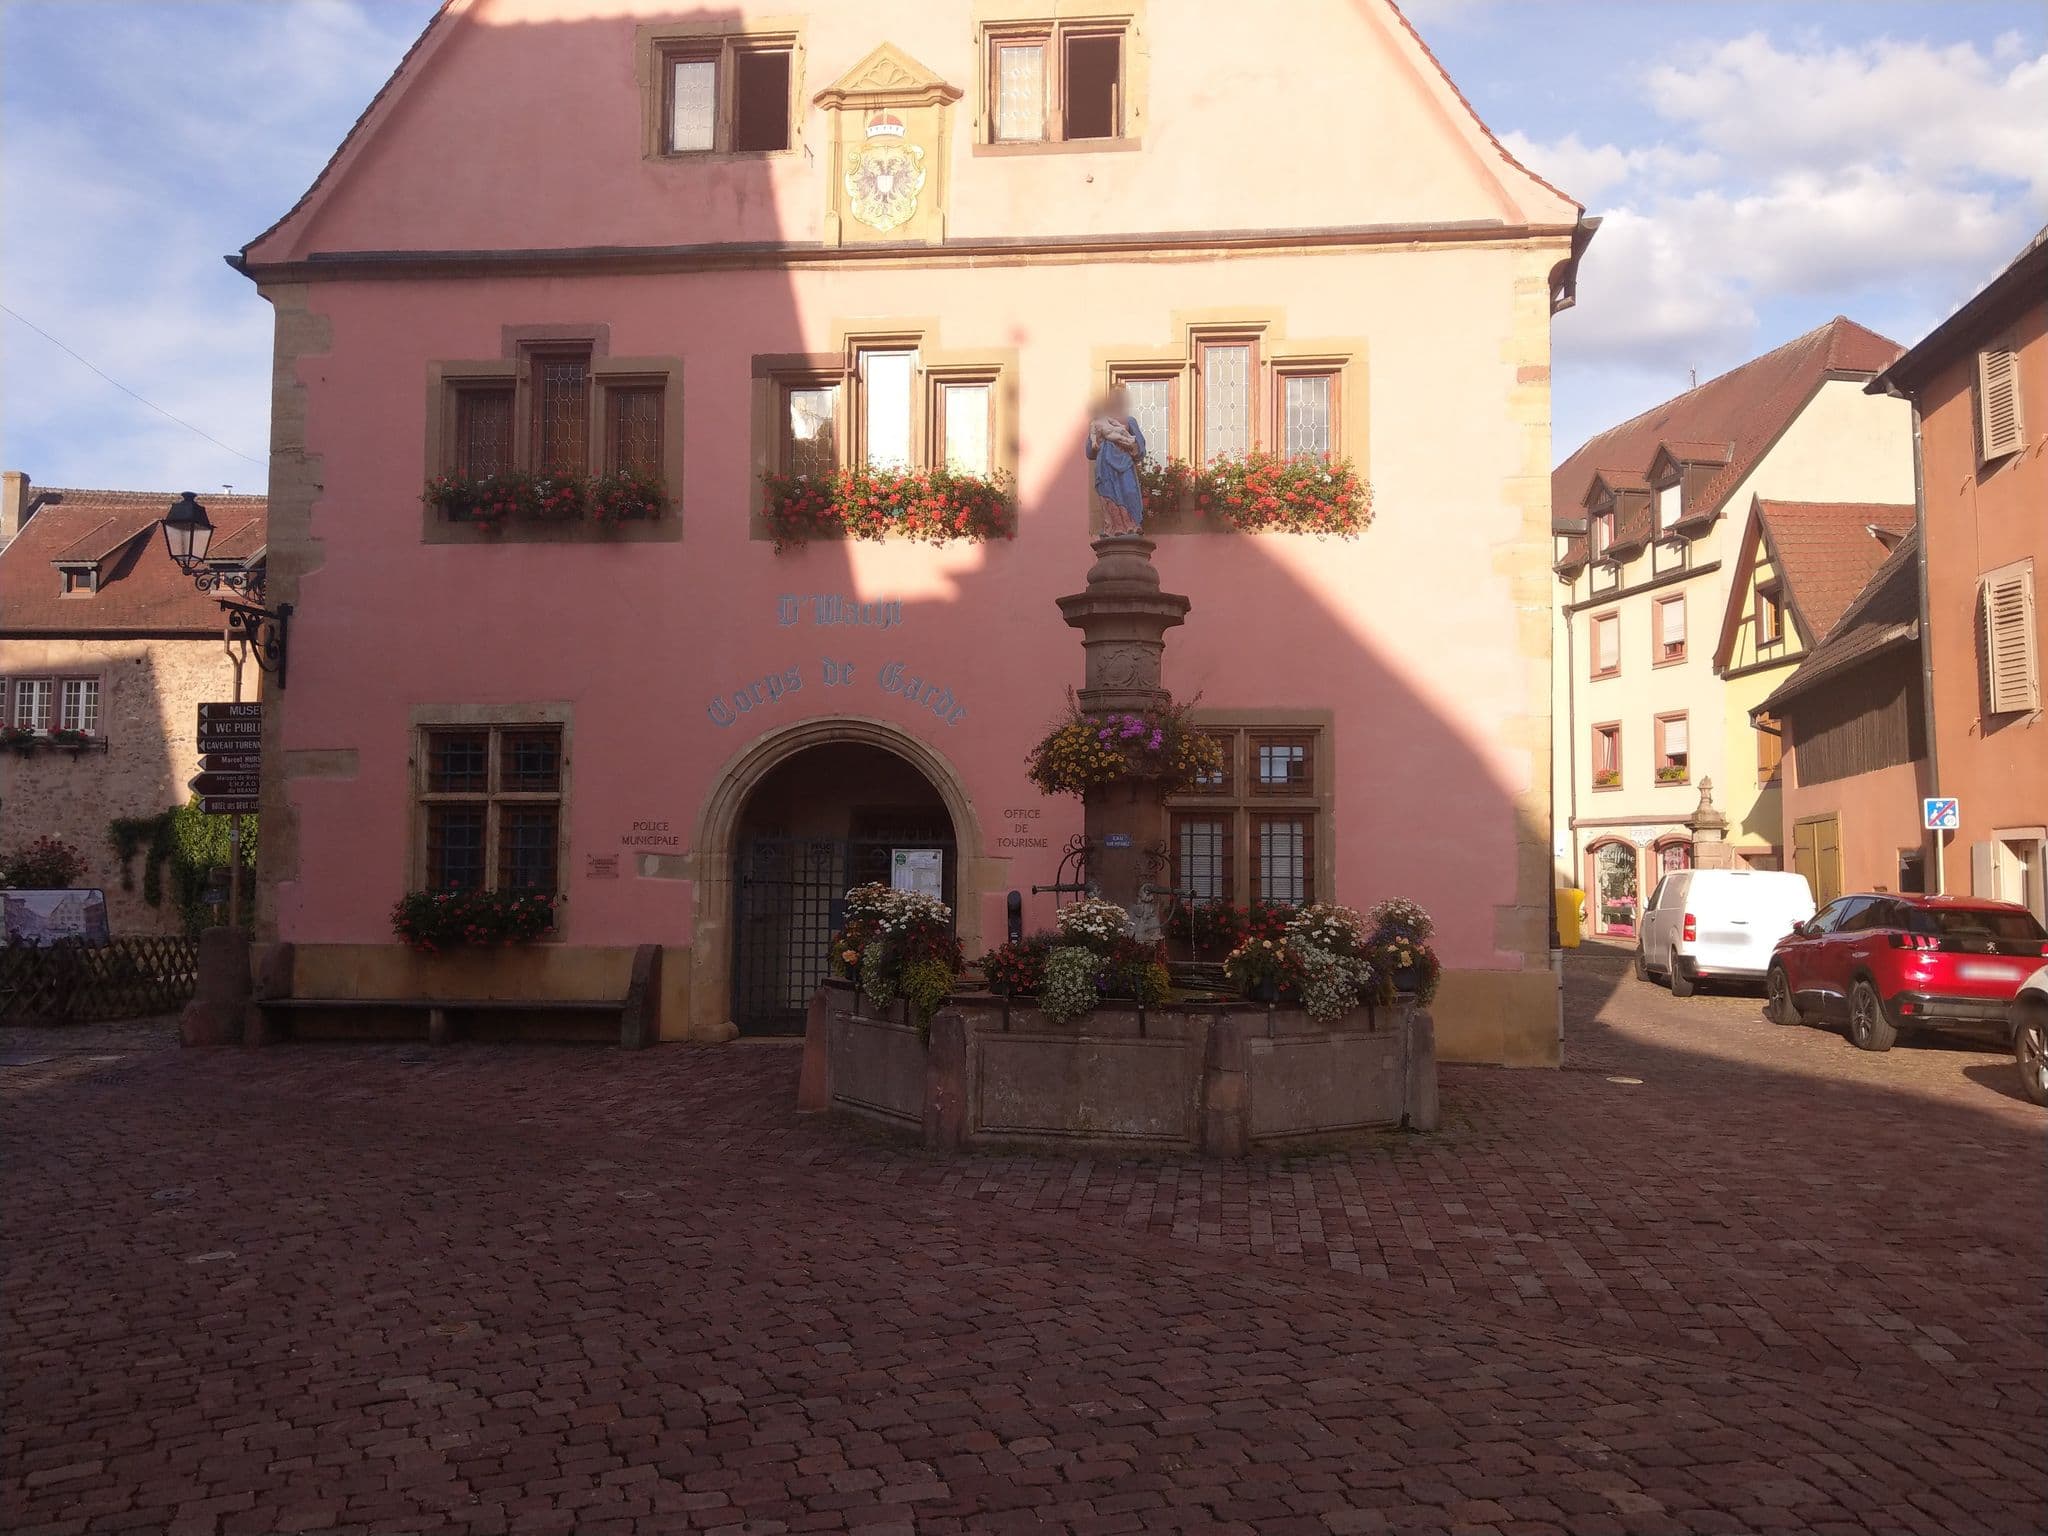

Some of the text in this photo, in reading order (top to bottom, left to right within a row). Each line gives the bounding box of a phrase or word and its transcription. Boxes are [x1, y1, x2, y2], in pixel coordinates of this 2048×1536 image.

[707, 656, 968, 728] Corps de Garde
[215, 722, 261, 733] WC PUBLI
[206, 741, 261, 750] CAVEAU TURENN
[1003, 809, 1041, 819] OFFICE
[632, 821, 669, 831] POLICE
[1015, 824, 1029, 833] DE
[622, 836, 679, 846] MUNICIPALE
[997, 837, 1048, 847] TOURISME
